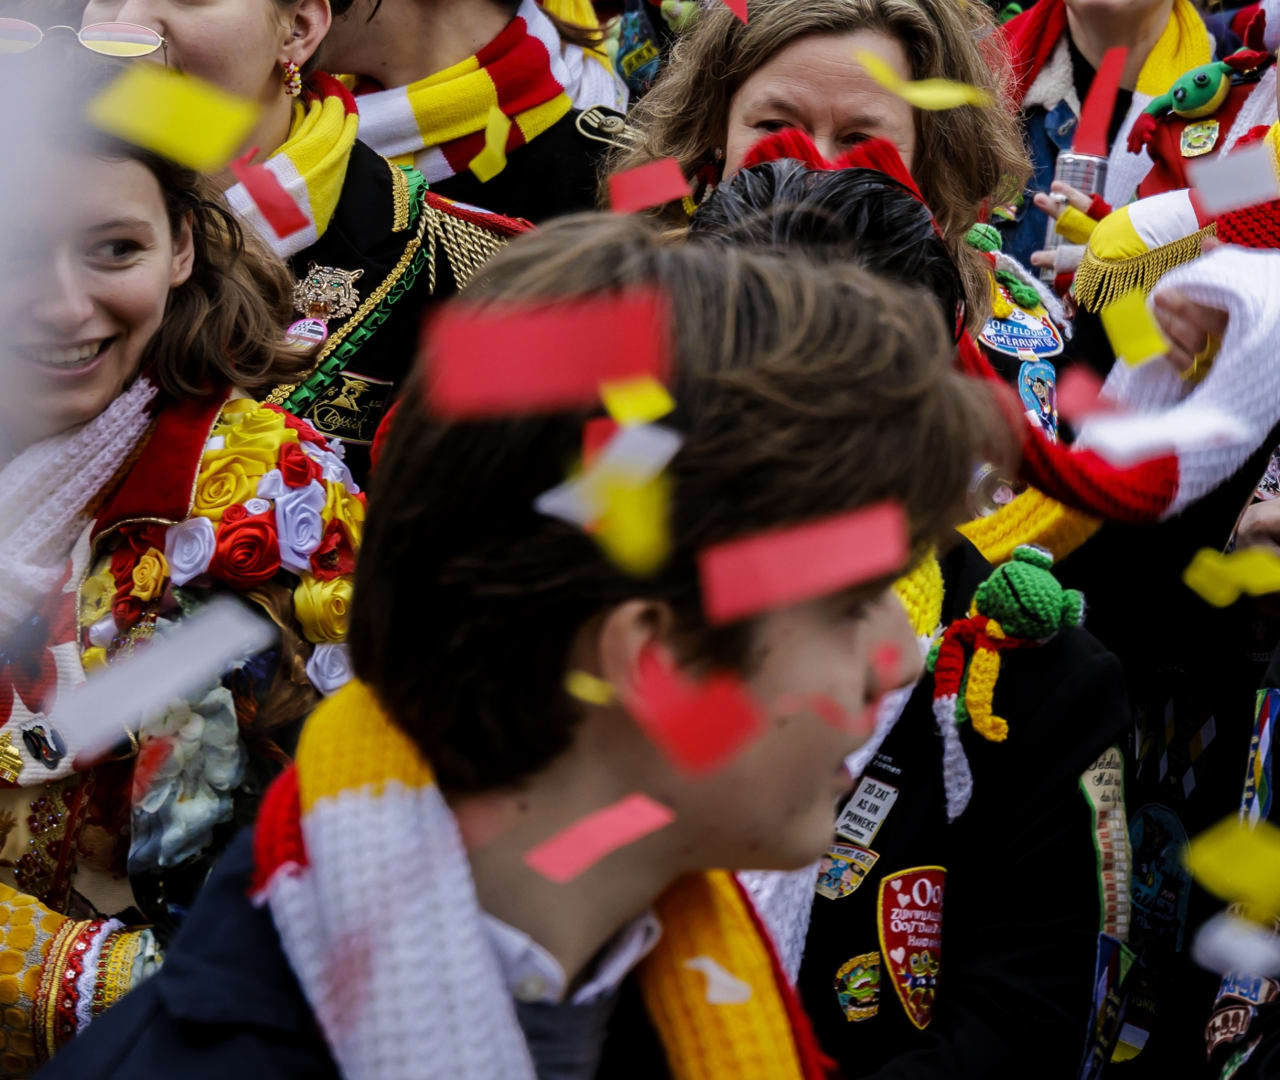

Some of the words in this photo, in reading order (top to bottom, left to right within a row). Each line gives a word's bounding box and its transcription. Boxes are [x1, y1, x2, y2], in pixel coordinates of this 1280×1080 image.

[874, 788, 891, 801] ZAT
[856, 798, 868, 810] AS
[843, 810, 878, 832] PINNEKE
